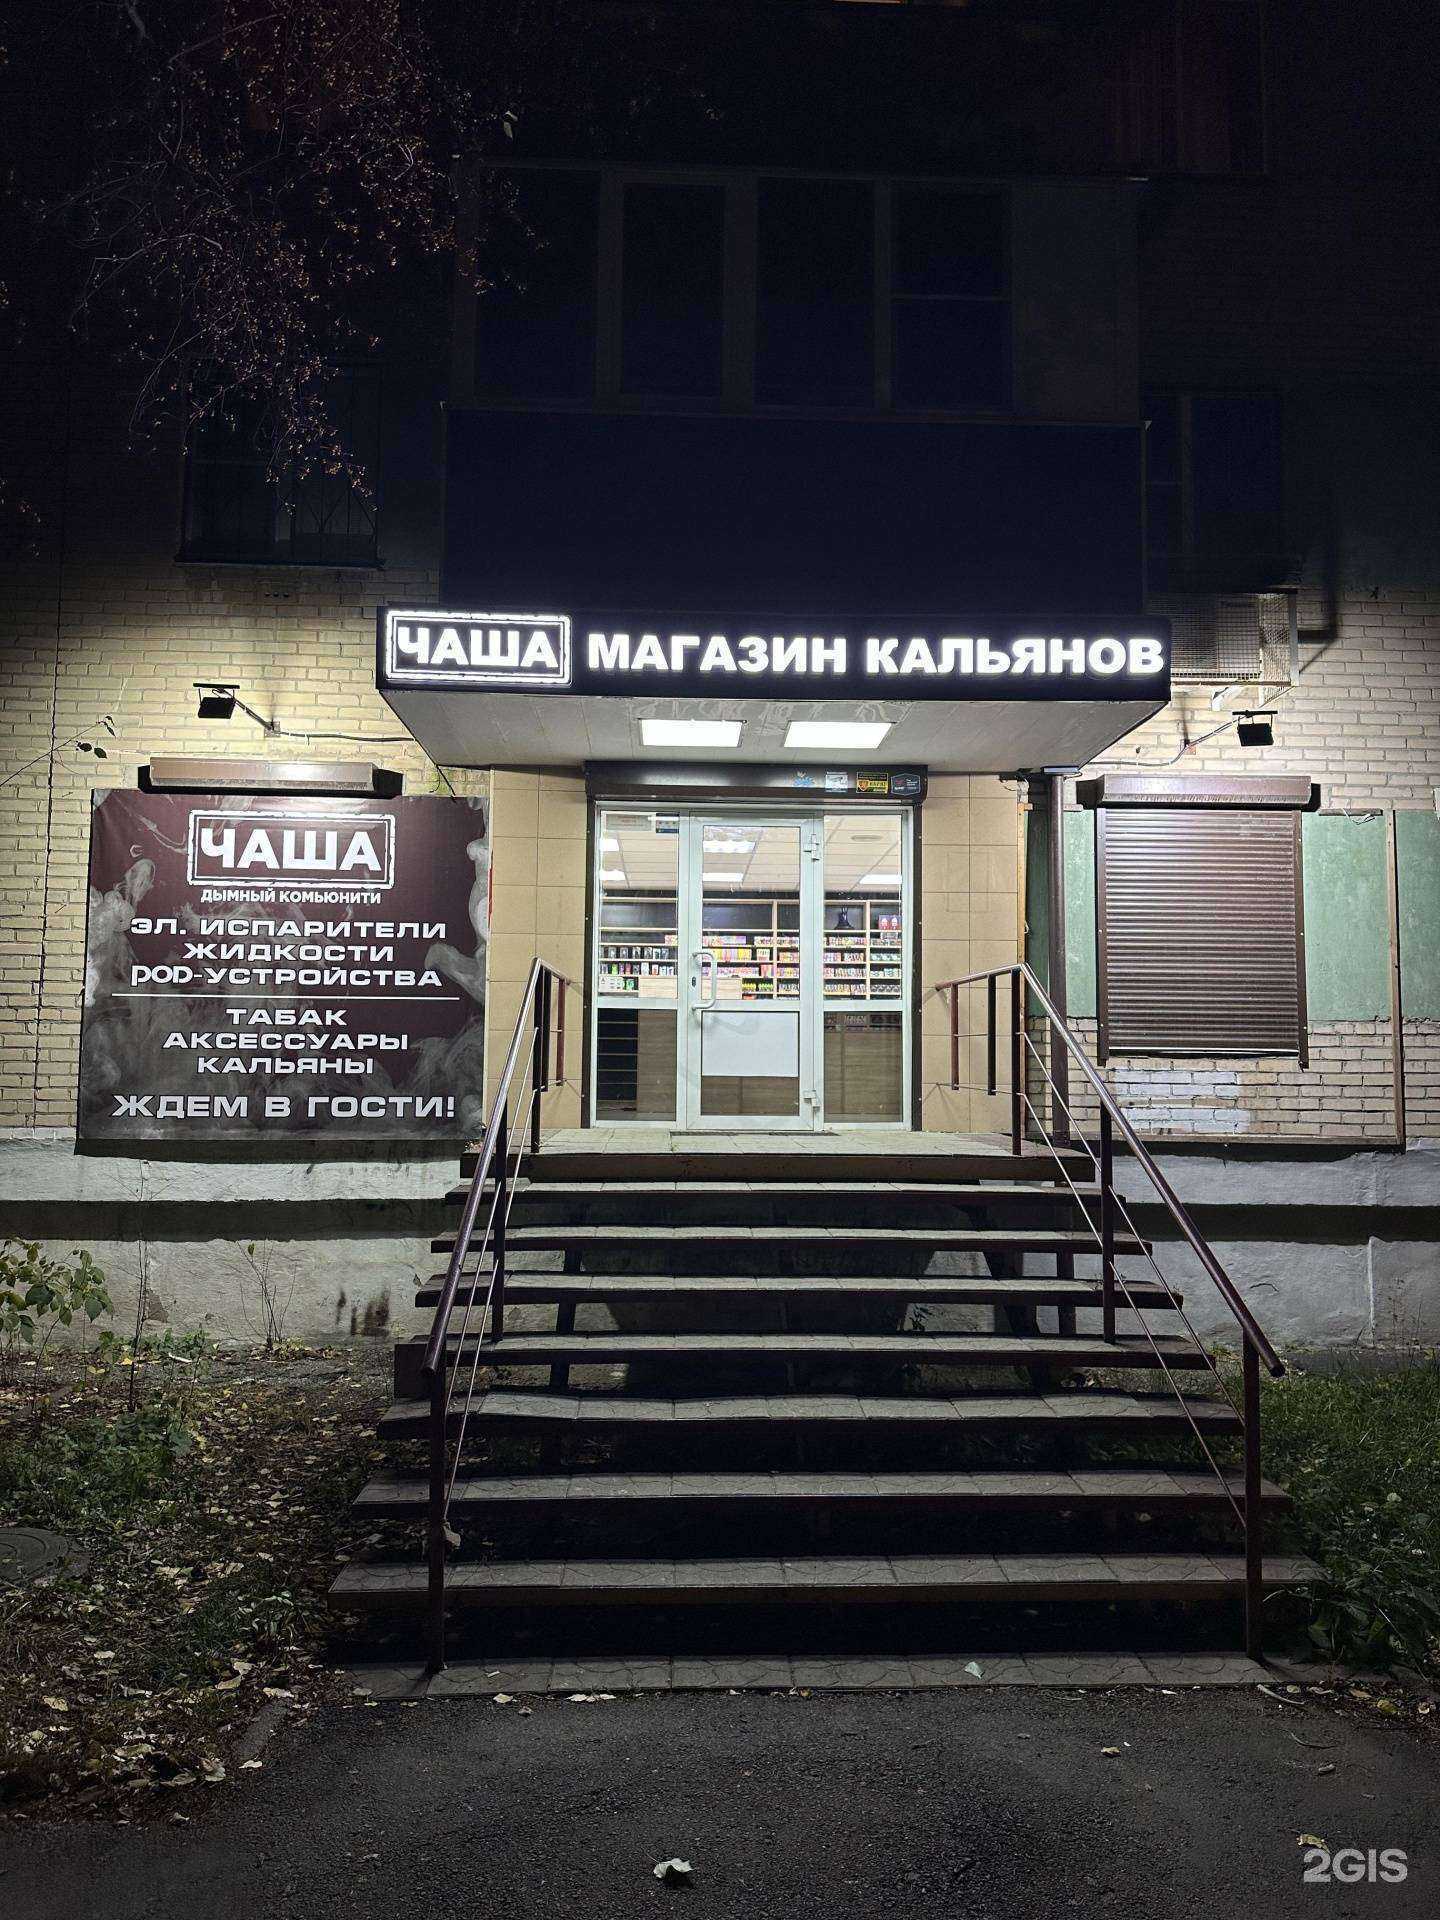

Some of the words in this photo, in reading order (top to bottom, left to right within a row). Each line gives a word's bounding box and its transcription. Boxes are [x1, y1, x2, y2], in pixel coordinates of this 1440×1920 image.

[397, 627, 559, 668] ЧАША
[588, 633, 847, 673] МАГАЗИН
[866, 638, 1164, 674] КАЛЬЯНОВ
[200, 829, 381, 871] ЧАША
[200, 888, 276, 904] ДЫМНЫЙ
[279, 890, 381, 904] КОМЬЮНИТИ
[130, 918, 187, 936] ЭЛ.
[200, 920, 447, 939] ИСПАРИТЕЛИ
[182, 943, 394, 962] ЖИДКОСТИ
[226, 1008, 347, 1026] ТАБАК
[162, 1032, 408, 1050] АКСЕССУАРЫ
[197, 1057, 374, 1075] КАЛЬЯНЫ
[112, 1094, 248, 1120] ЖДЕМ
[264, 1096, 291, 1118] В
[308, 1096, 456, 1118] ГОСТИ!
